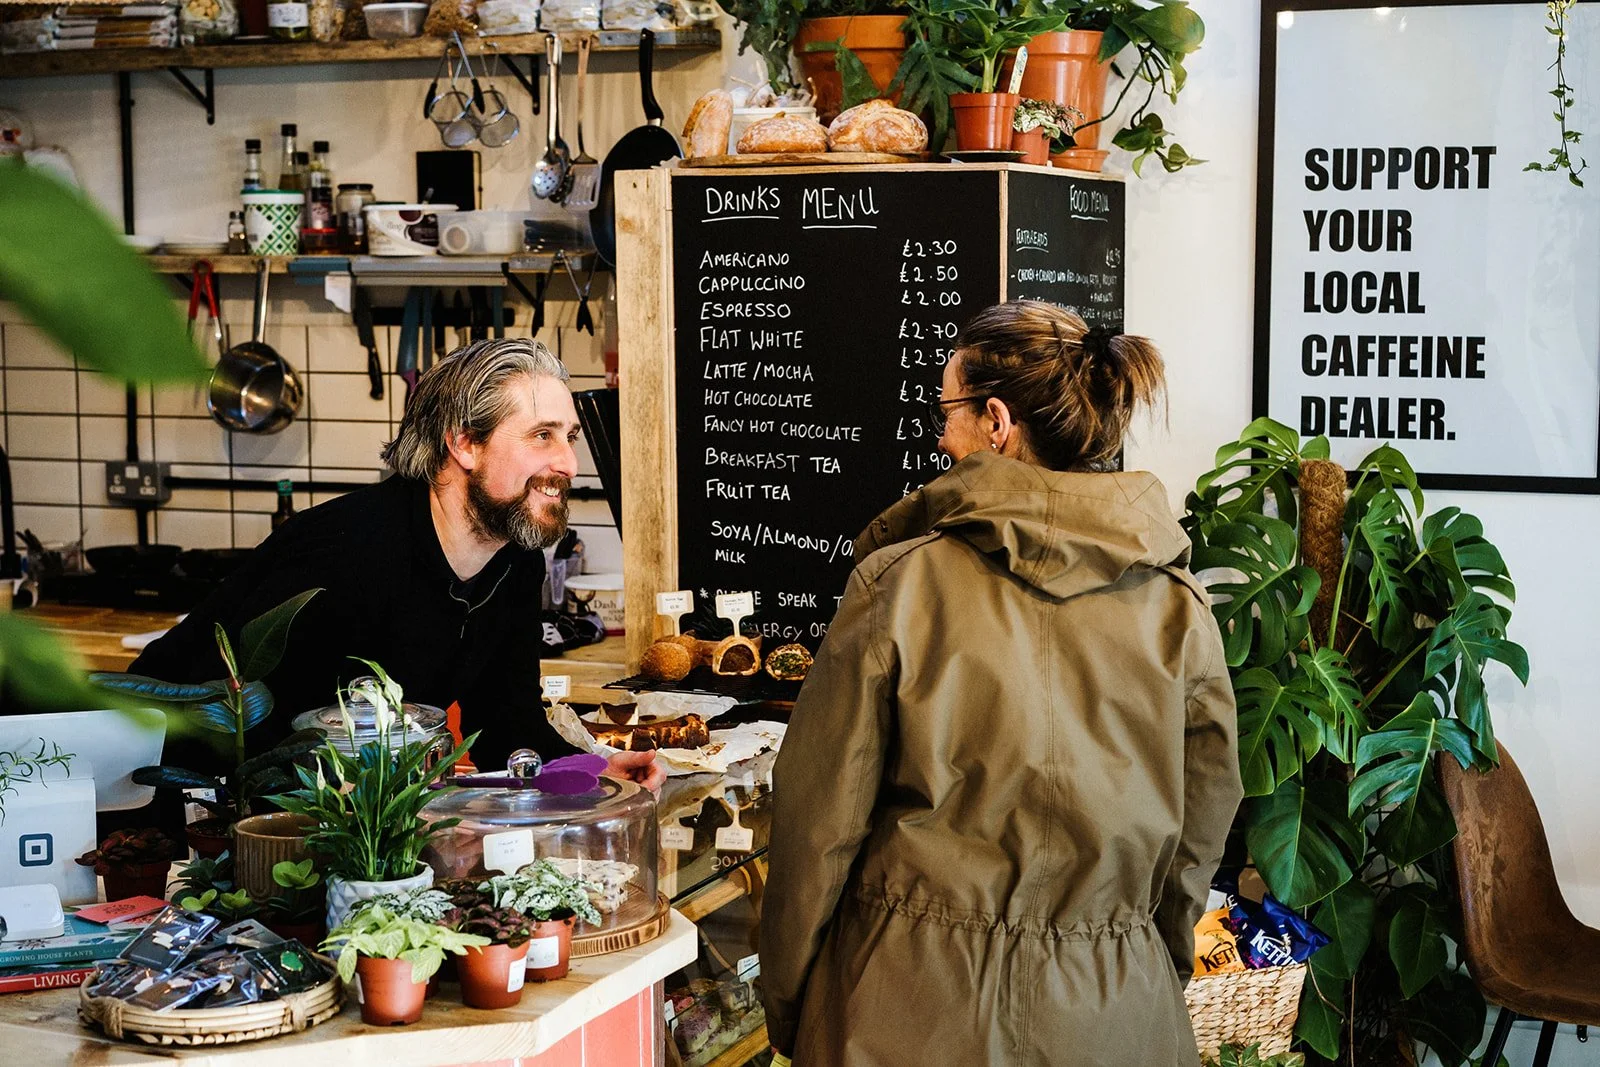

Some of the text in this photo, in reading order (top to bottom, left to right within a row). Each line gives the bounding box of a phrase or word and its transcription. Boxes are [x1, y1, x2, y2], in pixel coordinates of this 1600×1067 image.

[1304, 146, 1497, 192] SUPPORT
[706, 186, 879, 220] DRINKS MENU
[1070, 184, 1089, 213] FOOD
[1302, 209, 1412, 253] YOUR
[699, 238, 957, 270] AMERICANO £2.30
[698, 262, 958, 295] CAPPUCCINO £2.50
[1303, 270, 1426, 314] LOCAL
[700, 289, 962, 320] ESPRESSO £2.00
[700, 318, 958, 352] FLAT WHITE £2.70
[1301, 334, 1486, 379] CAFFEINE
[704, 388, 730, 407] HOT
[734, 390, 813, 409] CHOCOLATE
[704, 414, 744, 433] FANCY
[749, 419, 775, 433] HOT
[780, 421, 862, 442] CHOCOLATE
[1300, 395, 1456, 441] DEALER.
[705, 447, 952, 474] BREAKFAST TEA £1.90
[706, 478, 791, 501] FRUIT TEA
[715, 548, 746, 564] MILK
[778, 591, 818, 608] SPEAK
[37, 951, 62, 961] HOUSE
[64, 949, 94, 958] PLANTS
[33, 972, 81, 989] LIVING
